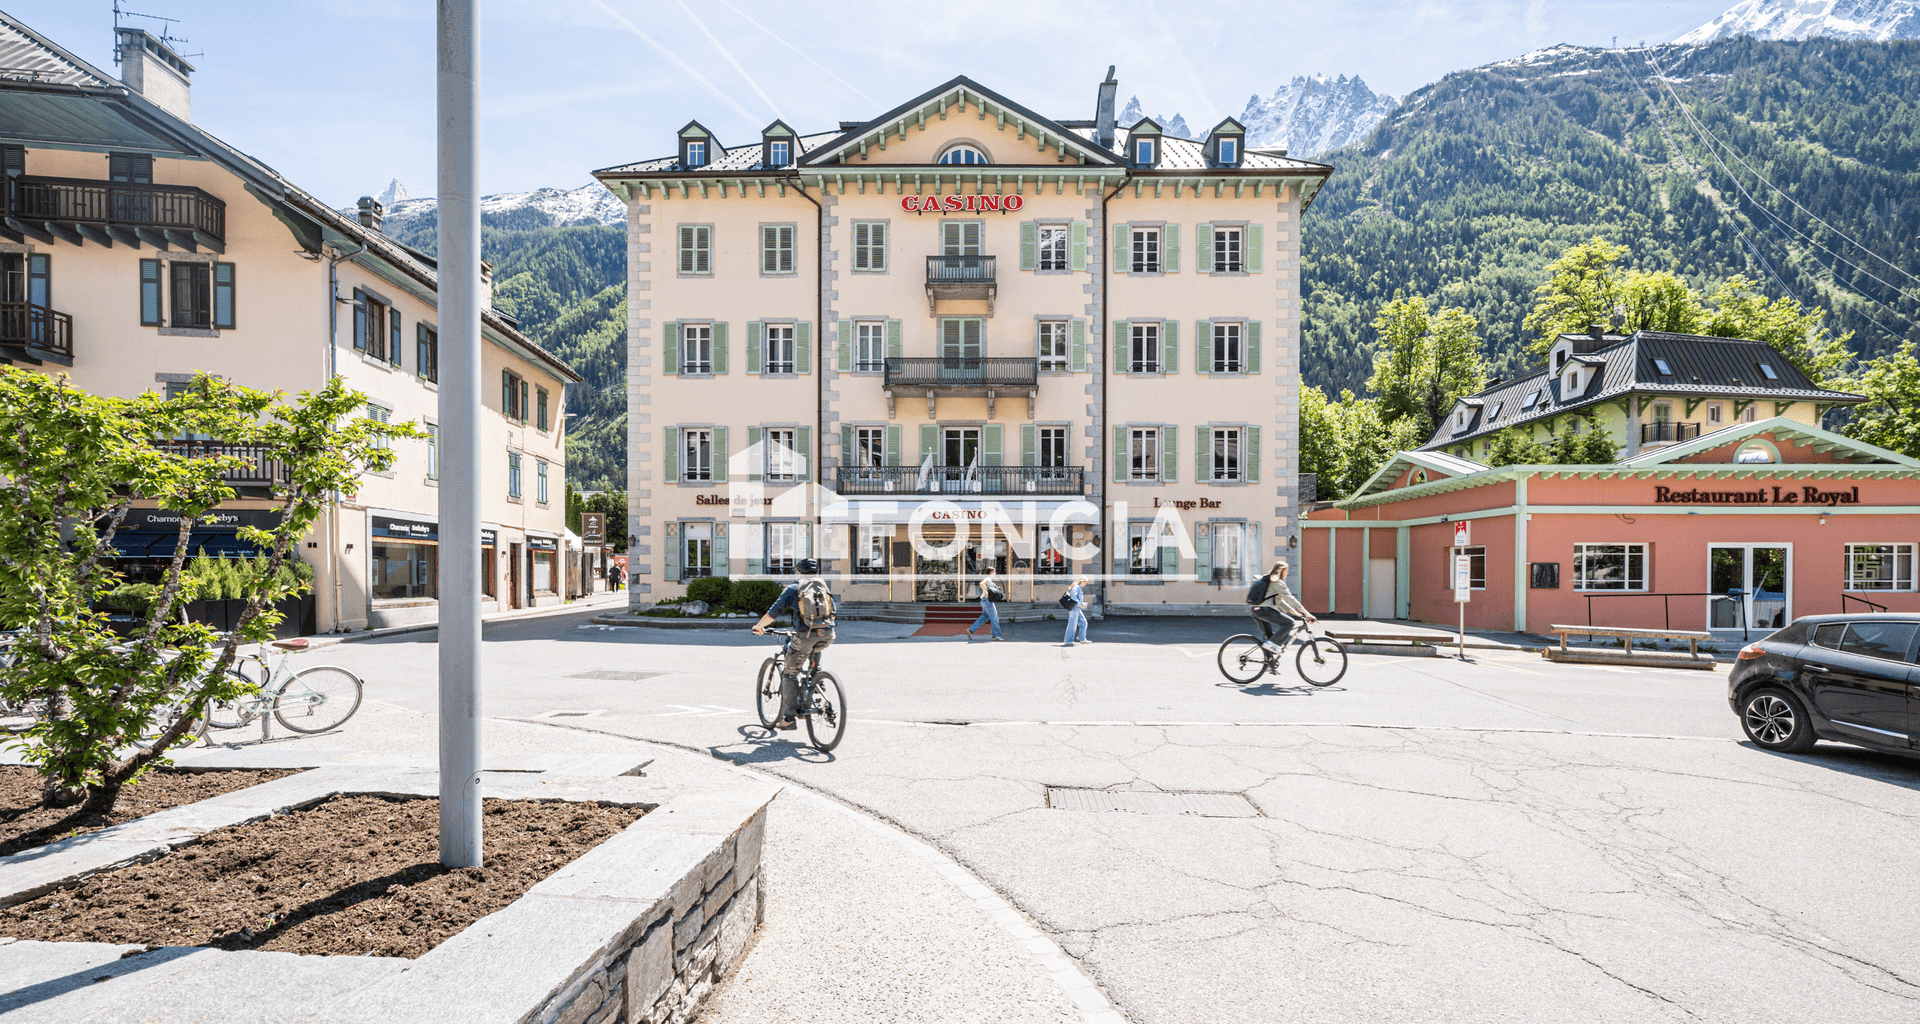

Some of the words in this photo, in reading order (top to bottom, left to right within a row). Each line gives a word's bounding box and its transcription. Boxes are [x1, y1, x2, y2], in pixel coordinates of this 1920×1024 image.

[901, 194, 1024, 212] CASINO
[696, 494, 730, 506] Salles
[733, 494, 747, 506] de
[749, 494, 774, 508] jeux
[1655, 486, 1768, 504] Restaurant
[1772, 486, 1798, 504] Le
[1802, 486, 1860, 507] Royal
[1153, 497, 1197, 511] Lounge
[1199, 497, 1222, 509] Bar
[932, 510, 988, 520] CASINO
